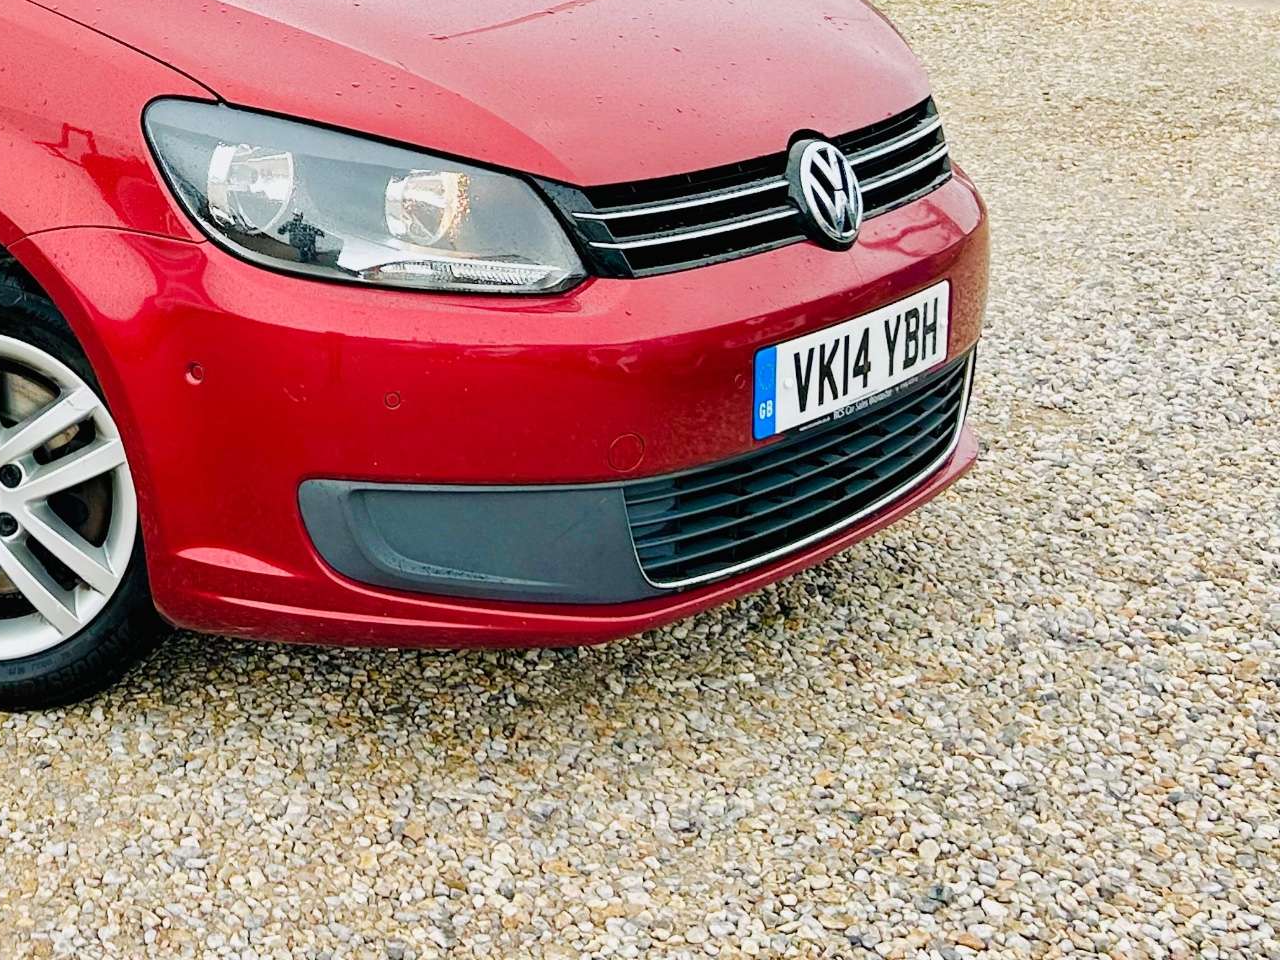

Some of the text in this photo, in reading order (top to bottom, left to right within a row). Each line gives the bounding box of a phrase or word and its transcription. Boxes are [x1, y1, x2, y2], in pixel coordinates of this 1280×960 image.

[793, 296, 939, 414] VK14 YBH
[759, 399, 773, 420] GB
